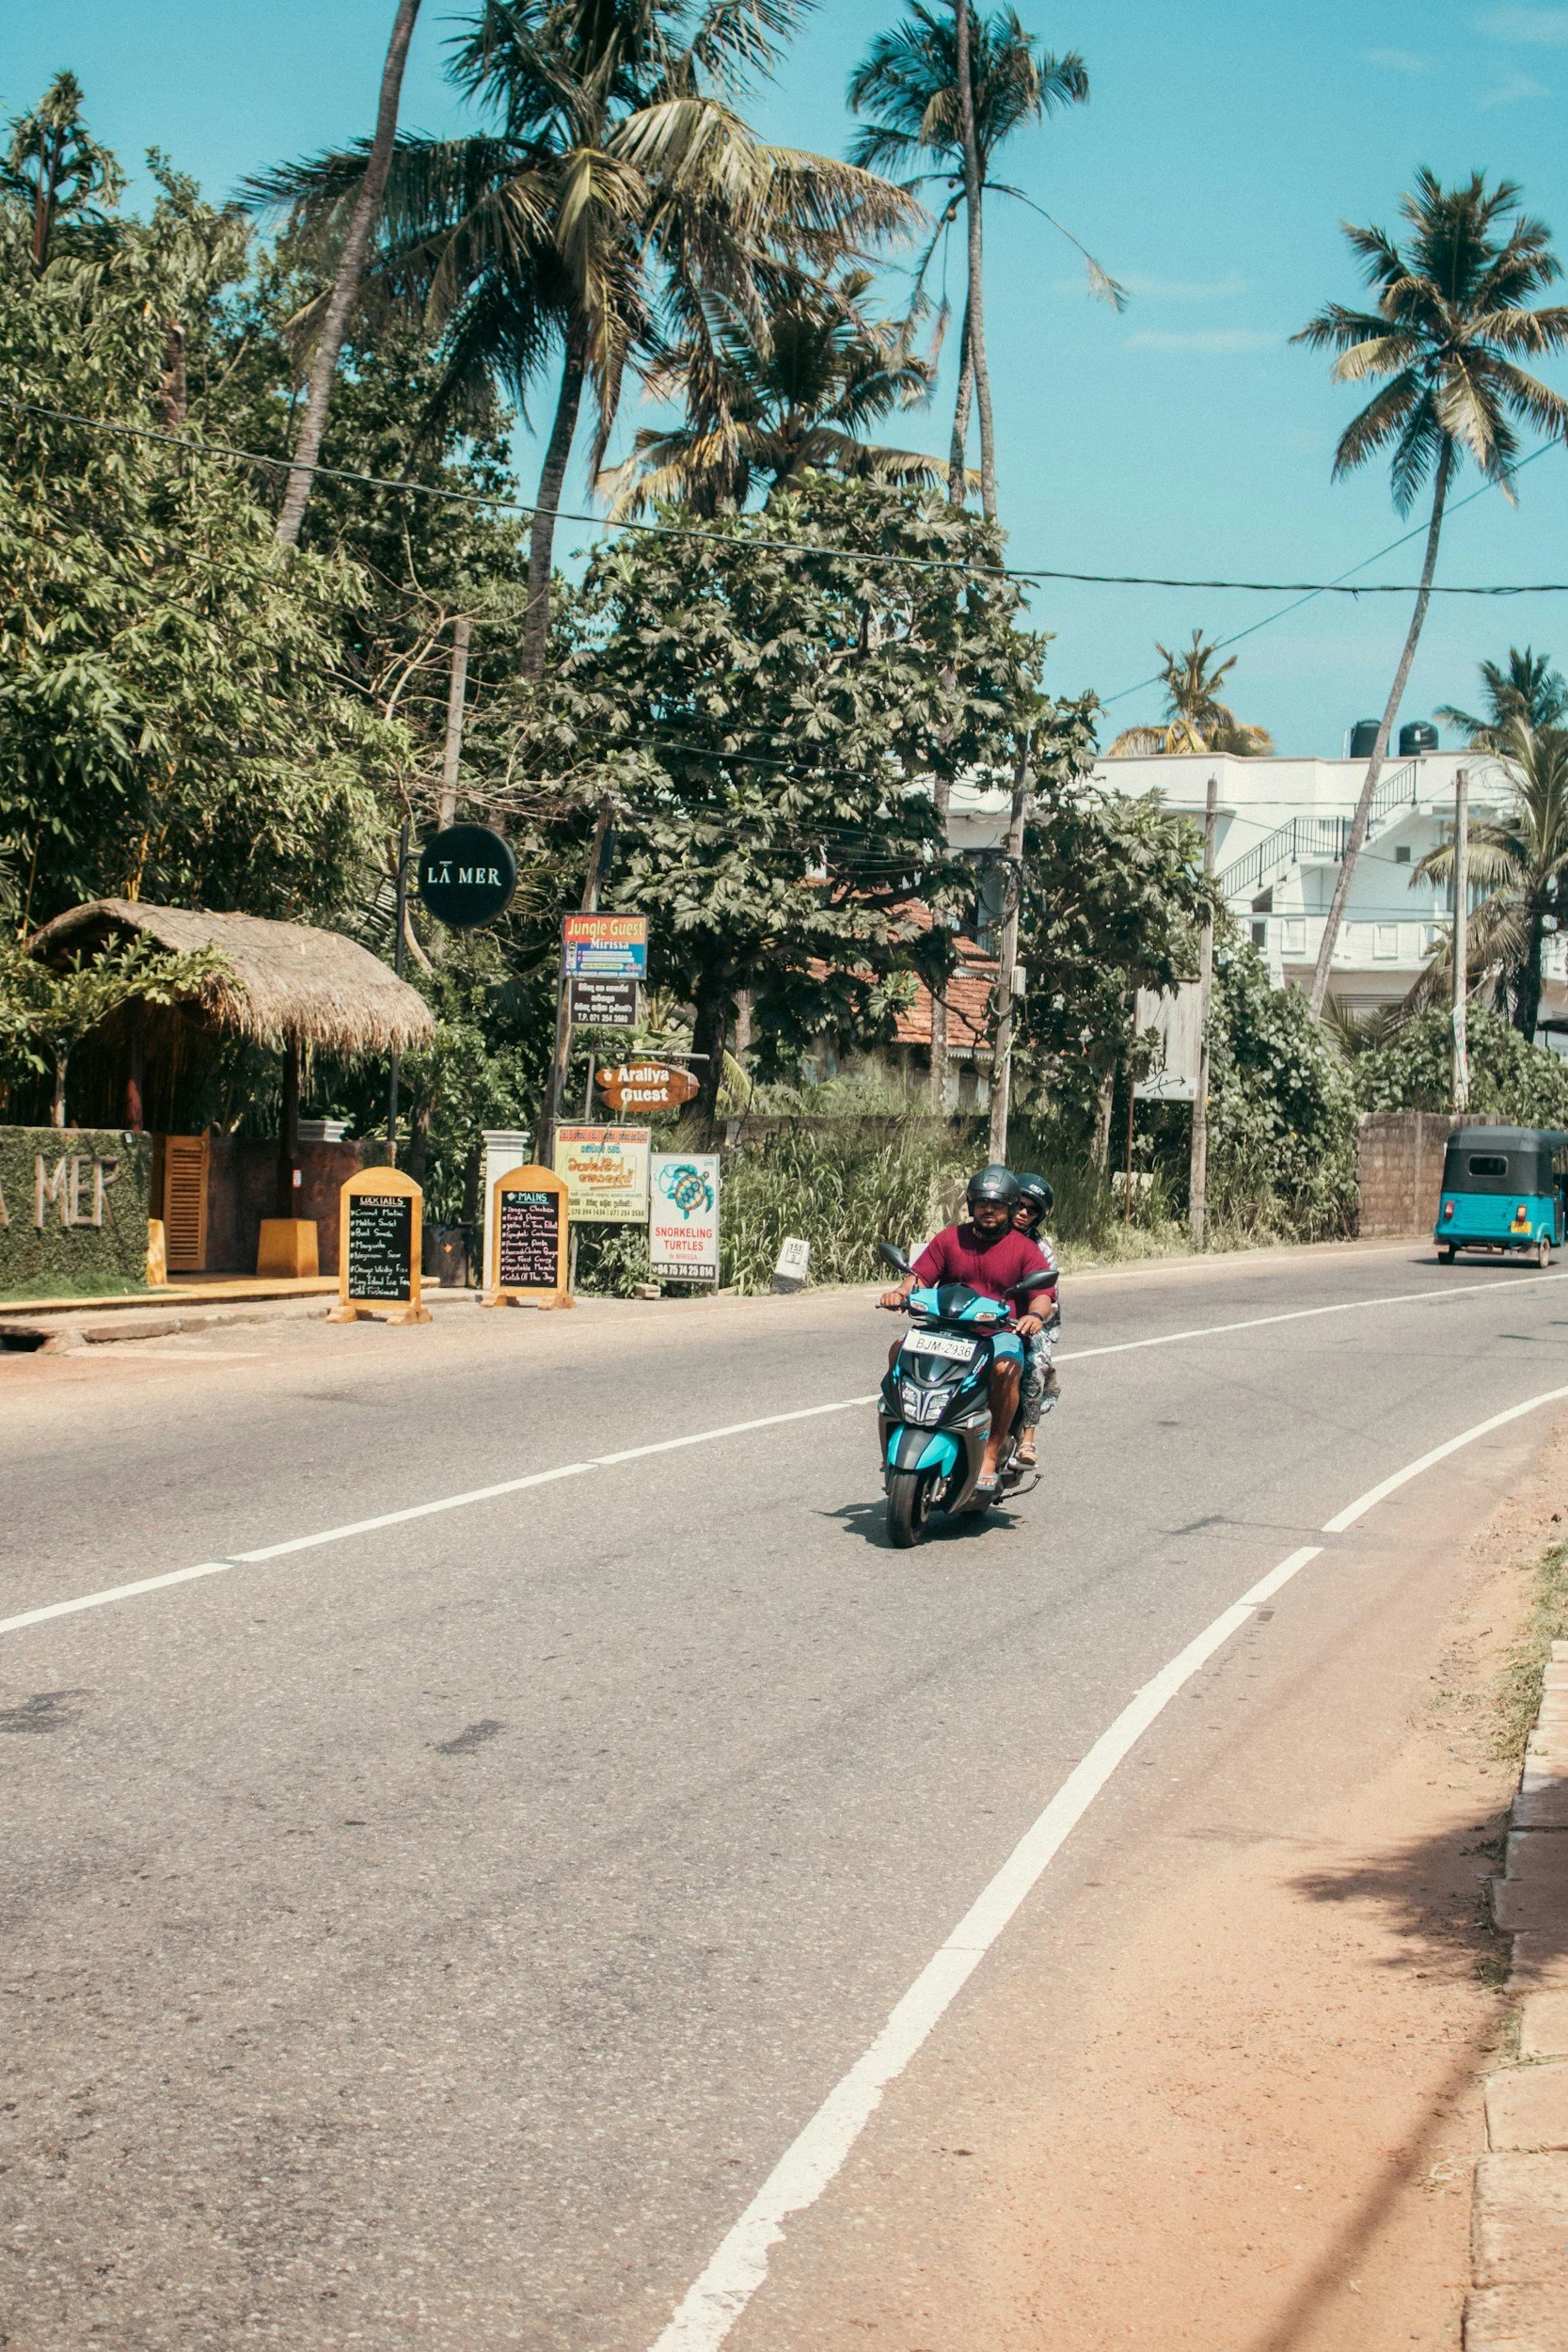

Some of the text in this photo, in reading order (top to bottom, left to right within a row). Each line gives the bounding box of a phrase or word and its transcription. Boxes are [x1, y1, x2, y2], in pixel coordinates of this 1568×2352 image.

[459, 867, 502, 886] MER
[567, 919, 643, 938] Jungle Guest
[590, 938, 629, 949] Mirissa
[590, 1013, 599, 1022] 071
[618, 1068, 670, 1084] Araliya
[621, 1088, 669, 1102] Guest
[34, 1153, 120, 1228] MER
[518, 1193, 546, 1201] MAINS
[656, 1227, 712, 1238] SNORKELING
[664, 1240, 704, 1250] TURTLES
[653, 1264, 713, 1277] +94 75 74 25 814
[915, 1338, 973, 1358] BJM-2936
